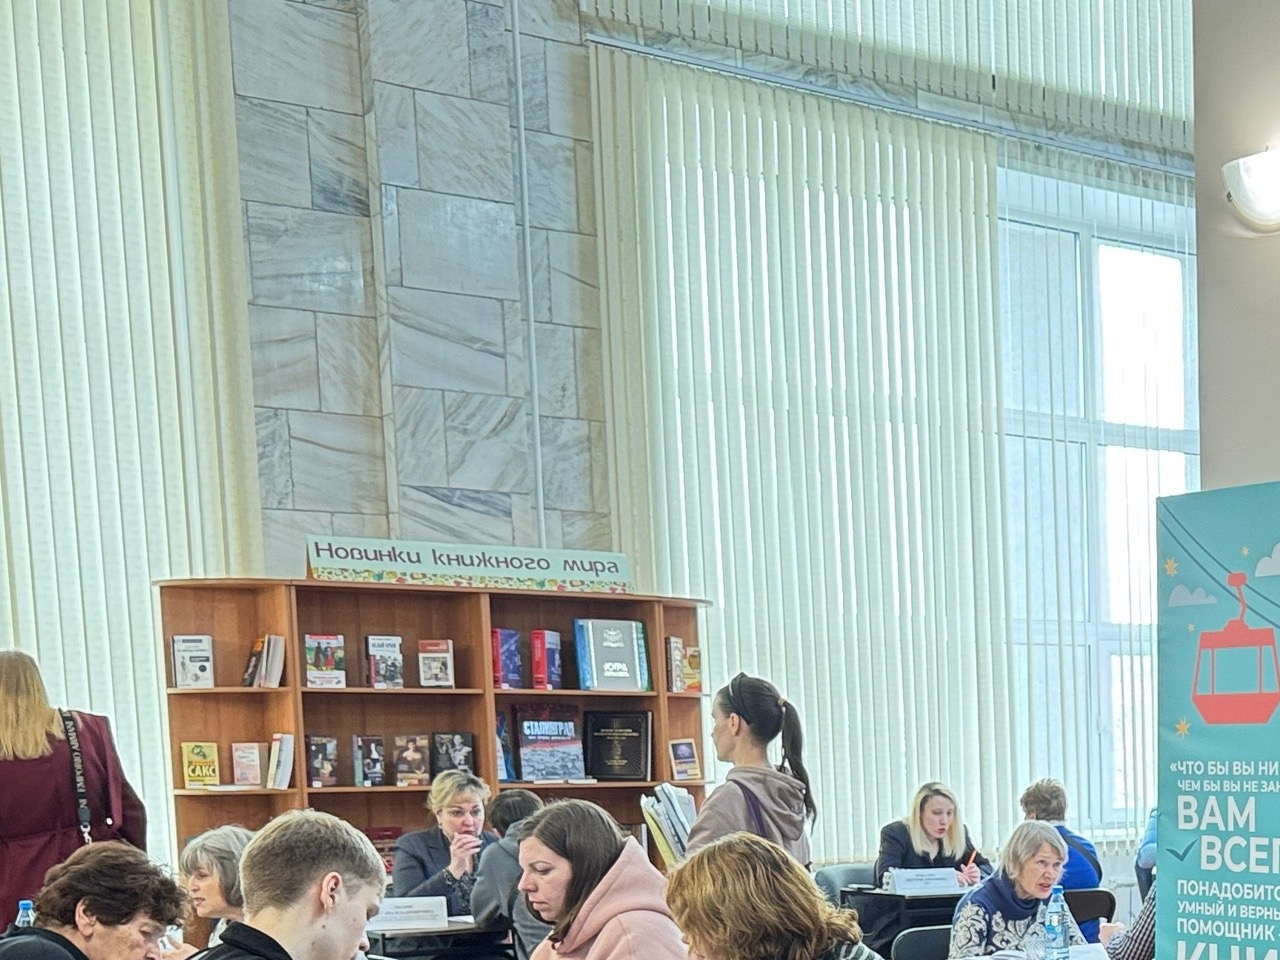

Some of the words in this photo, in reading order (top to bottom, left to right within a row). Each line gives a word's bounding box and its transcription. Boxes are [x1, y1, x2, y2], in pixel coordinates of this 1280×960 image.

[314, 541, 422, 565] Новинки
[433, 548, 550, 571] книжного
[563, 558, 619, 578] мира
[188, 764, 216, 777] САКС
[1170, 760, 1205, 776] «ЧТО
[1207, 760, 1229, 775] БЫ
[1232, 761, 1254, 776] ВЫ
[1258, 761, 1279, 776] НИ
[1177, 780, 1200, 792] ЧЕМ
[1203, 780, 1220, 792] БЫ
[1223, 780, 1241, 792] ВЫ
[1243, 780, 1259, 792] НЕ
[1177, 794, 1256, 832] ВАМ
[1177, 900, 1224, 916] УМНЫЙ
[1227, 905, 1237, 917] И
[1177, 917, 1275, 941] ПОМОЩНИК
